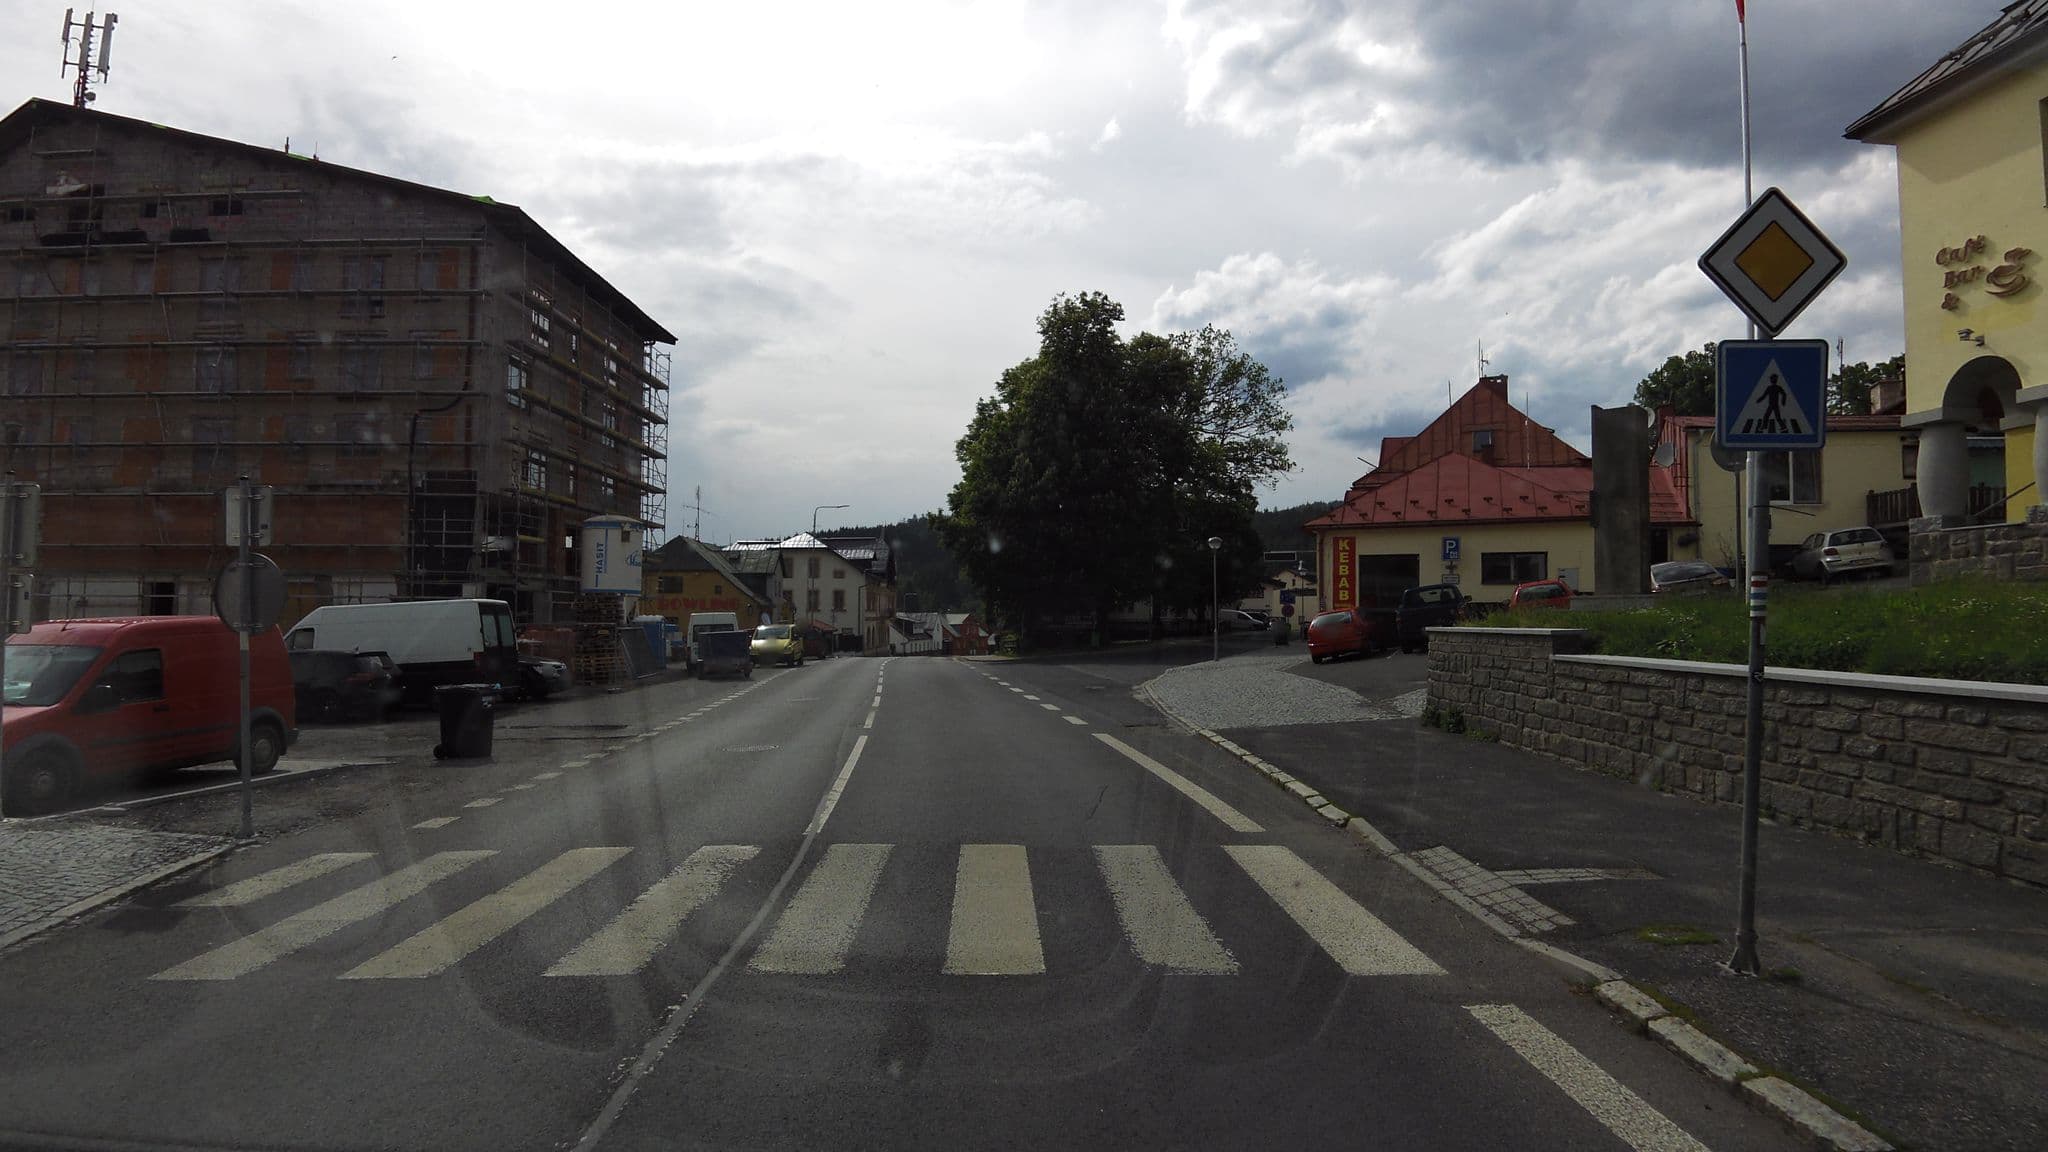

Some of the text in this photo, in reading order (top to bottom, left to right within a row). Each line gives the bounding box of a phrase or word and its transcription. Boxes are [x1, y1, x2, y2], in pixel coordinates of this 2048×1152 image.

[1944, 265, 1986, 288] Bar
[596, 542, 605, 574] HASIT
[1445, 540, 1457, 553] P
[1338, 539, 1350, 601] KEBAB
